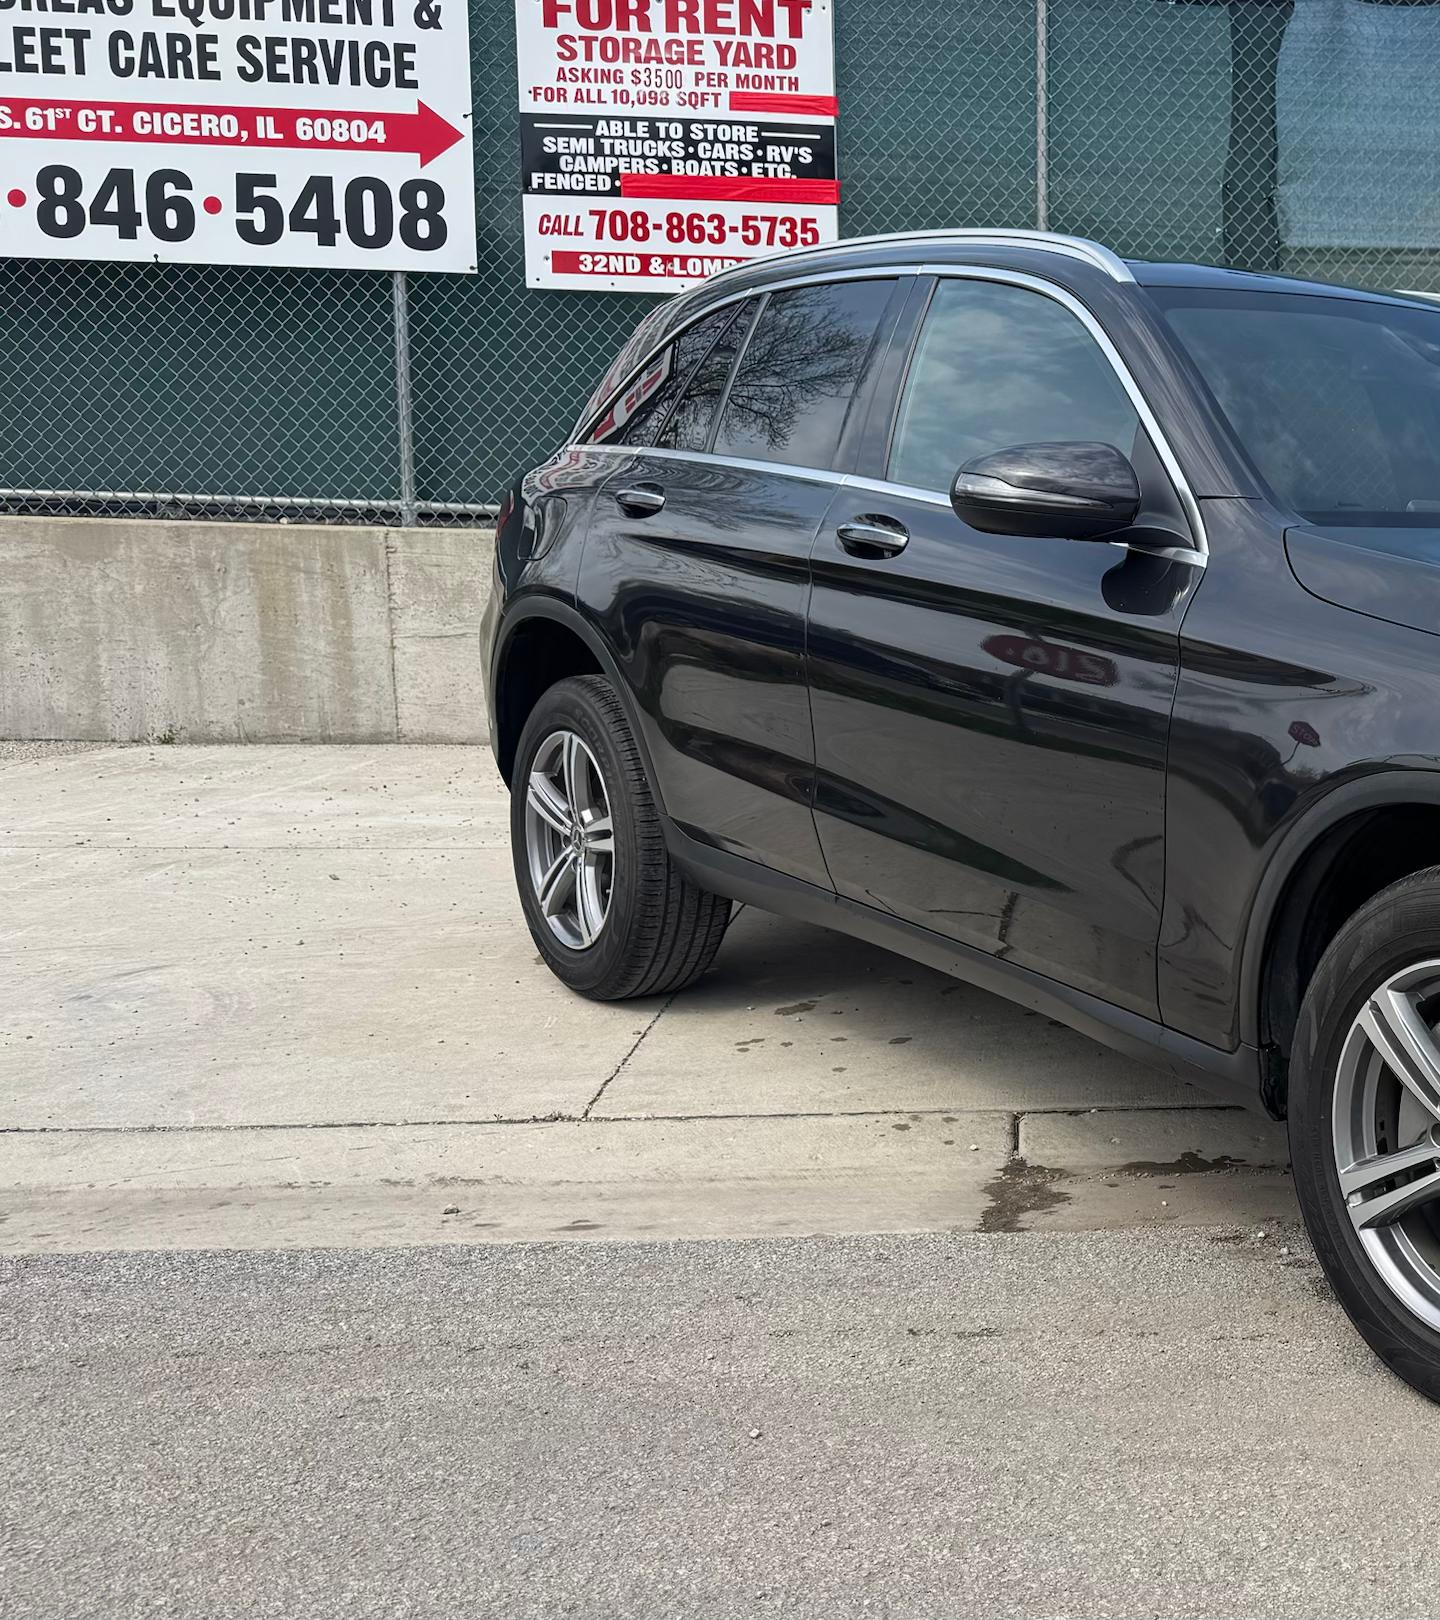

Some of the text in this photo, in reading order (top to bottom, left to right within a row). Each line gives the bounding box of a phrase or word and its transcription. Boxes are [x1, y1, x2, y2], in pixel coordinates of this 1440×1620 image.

[413, 0, 443, 30] &
[542, 0, 812, 39] FOR RENT
[0, 26, 420, 90] EET CARE SERVICE
[556, 34, 798, 71] STORAGE YARD
[556, 67, 800, 92] ASKING $3500 PER MONTH
[532, 86, 722, 110] FOR ALL 10,098 SQFT
[25, 106, 72, 131] 61ST
[77, 109, 123, 134] CT.
[132, 113, 250, 143] CICERO,
[255, 115, 284, 140] IL
[295, 118, 387, 144] 60804
[595, 119, 759, 143] ABLE TO STORE
[542, 136, 813, 164] SEMI TRUCKS CARS RV'S
[559, 155, 798, 180] CAMPERS BOATS ETC.
[531, 172, 612, 192] FENCED
[538, 209, 820, 247] CALL 708-863-5735
[578, 252, 747, 277] 32ND & LOM
